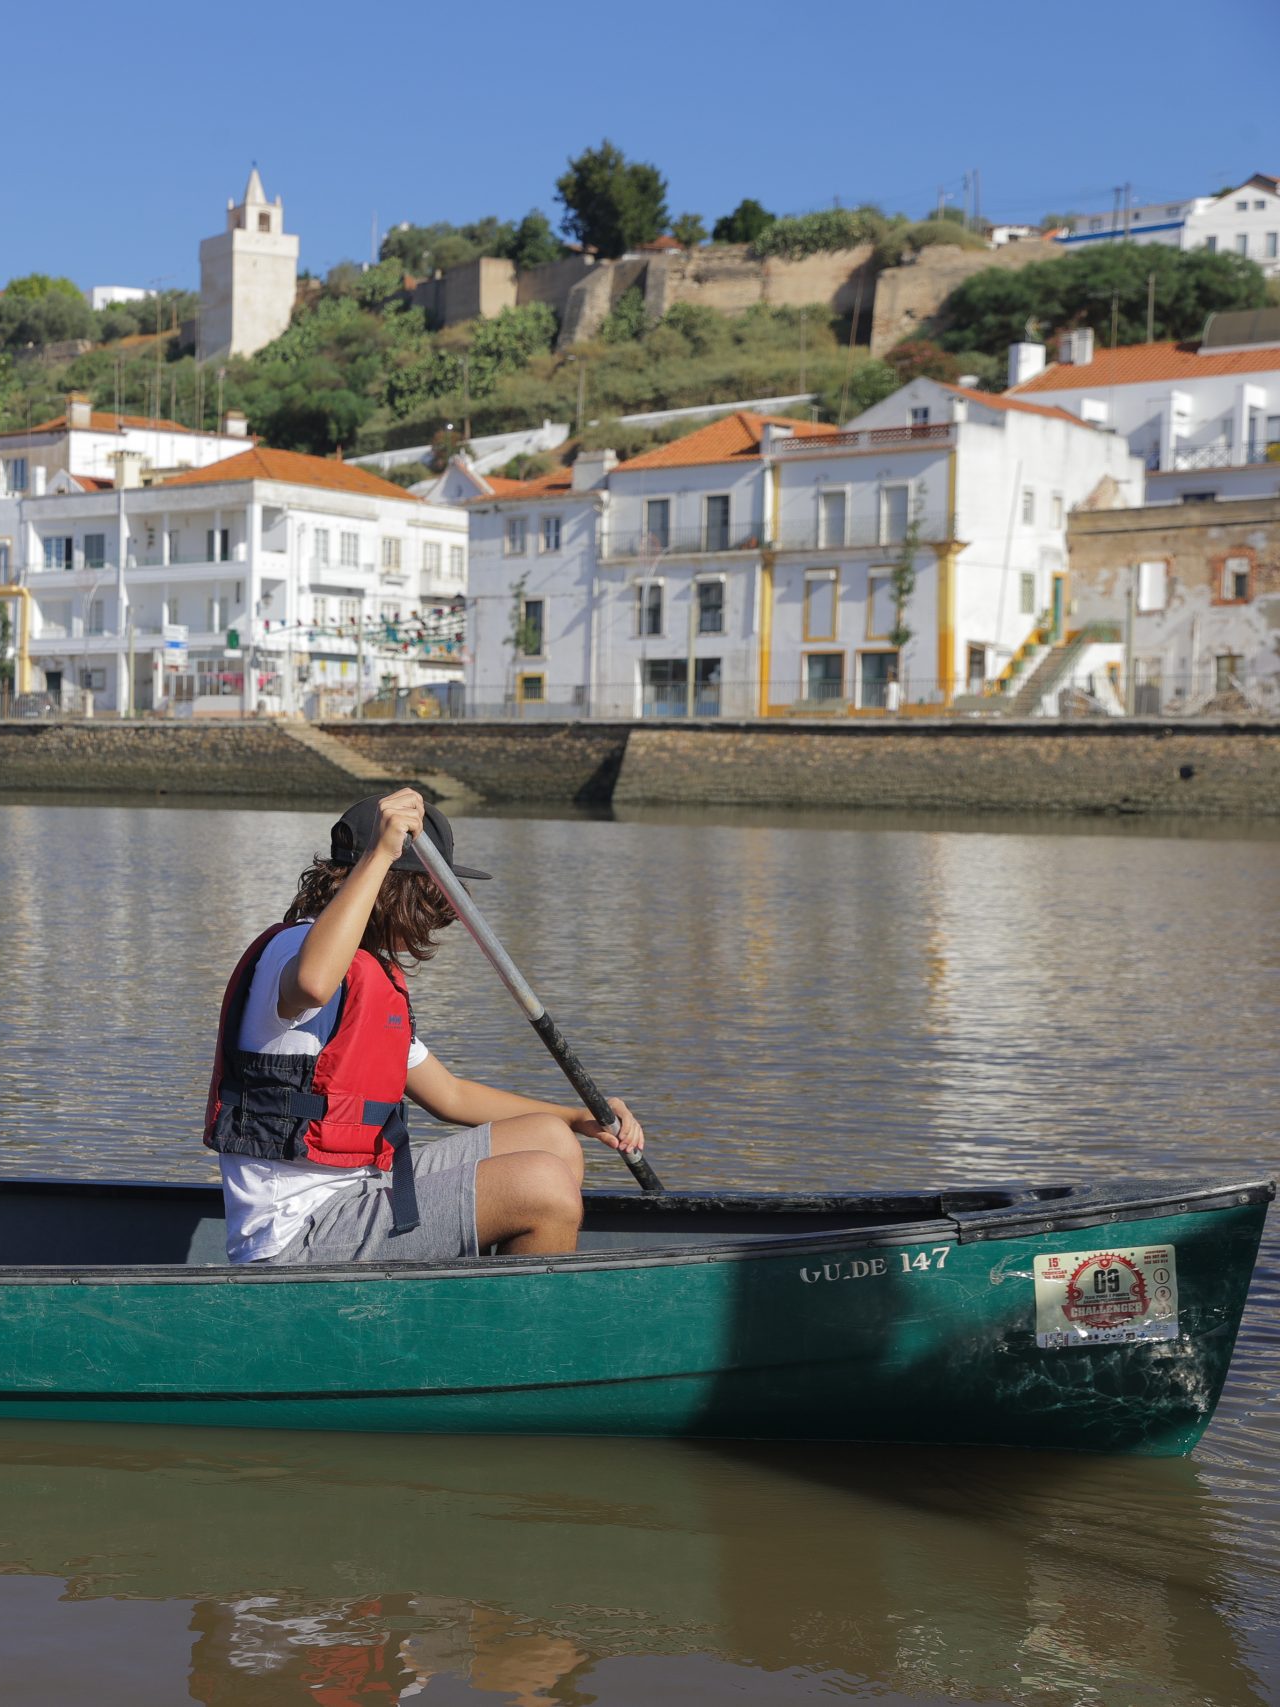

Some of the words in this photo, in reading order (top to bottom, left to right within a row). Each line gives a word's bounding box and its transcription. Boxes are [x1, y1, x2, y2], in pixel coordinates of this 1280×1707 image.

[799, 1258, 888, 1284] GUDE
[899, 1246, 951, 1273] 147
[1094, 1268, 1120, 1294] 09
[1070, 1302, 1143, 1318] CHALLENGER
